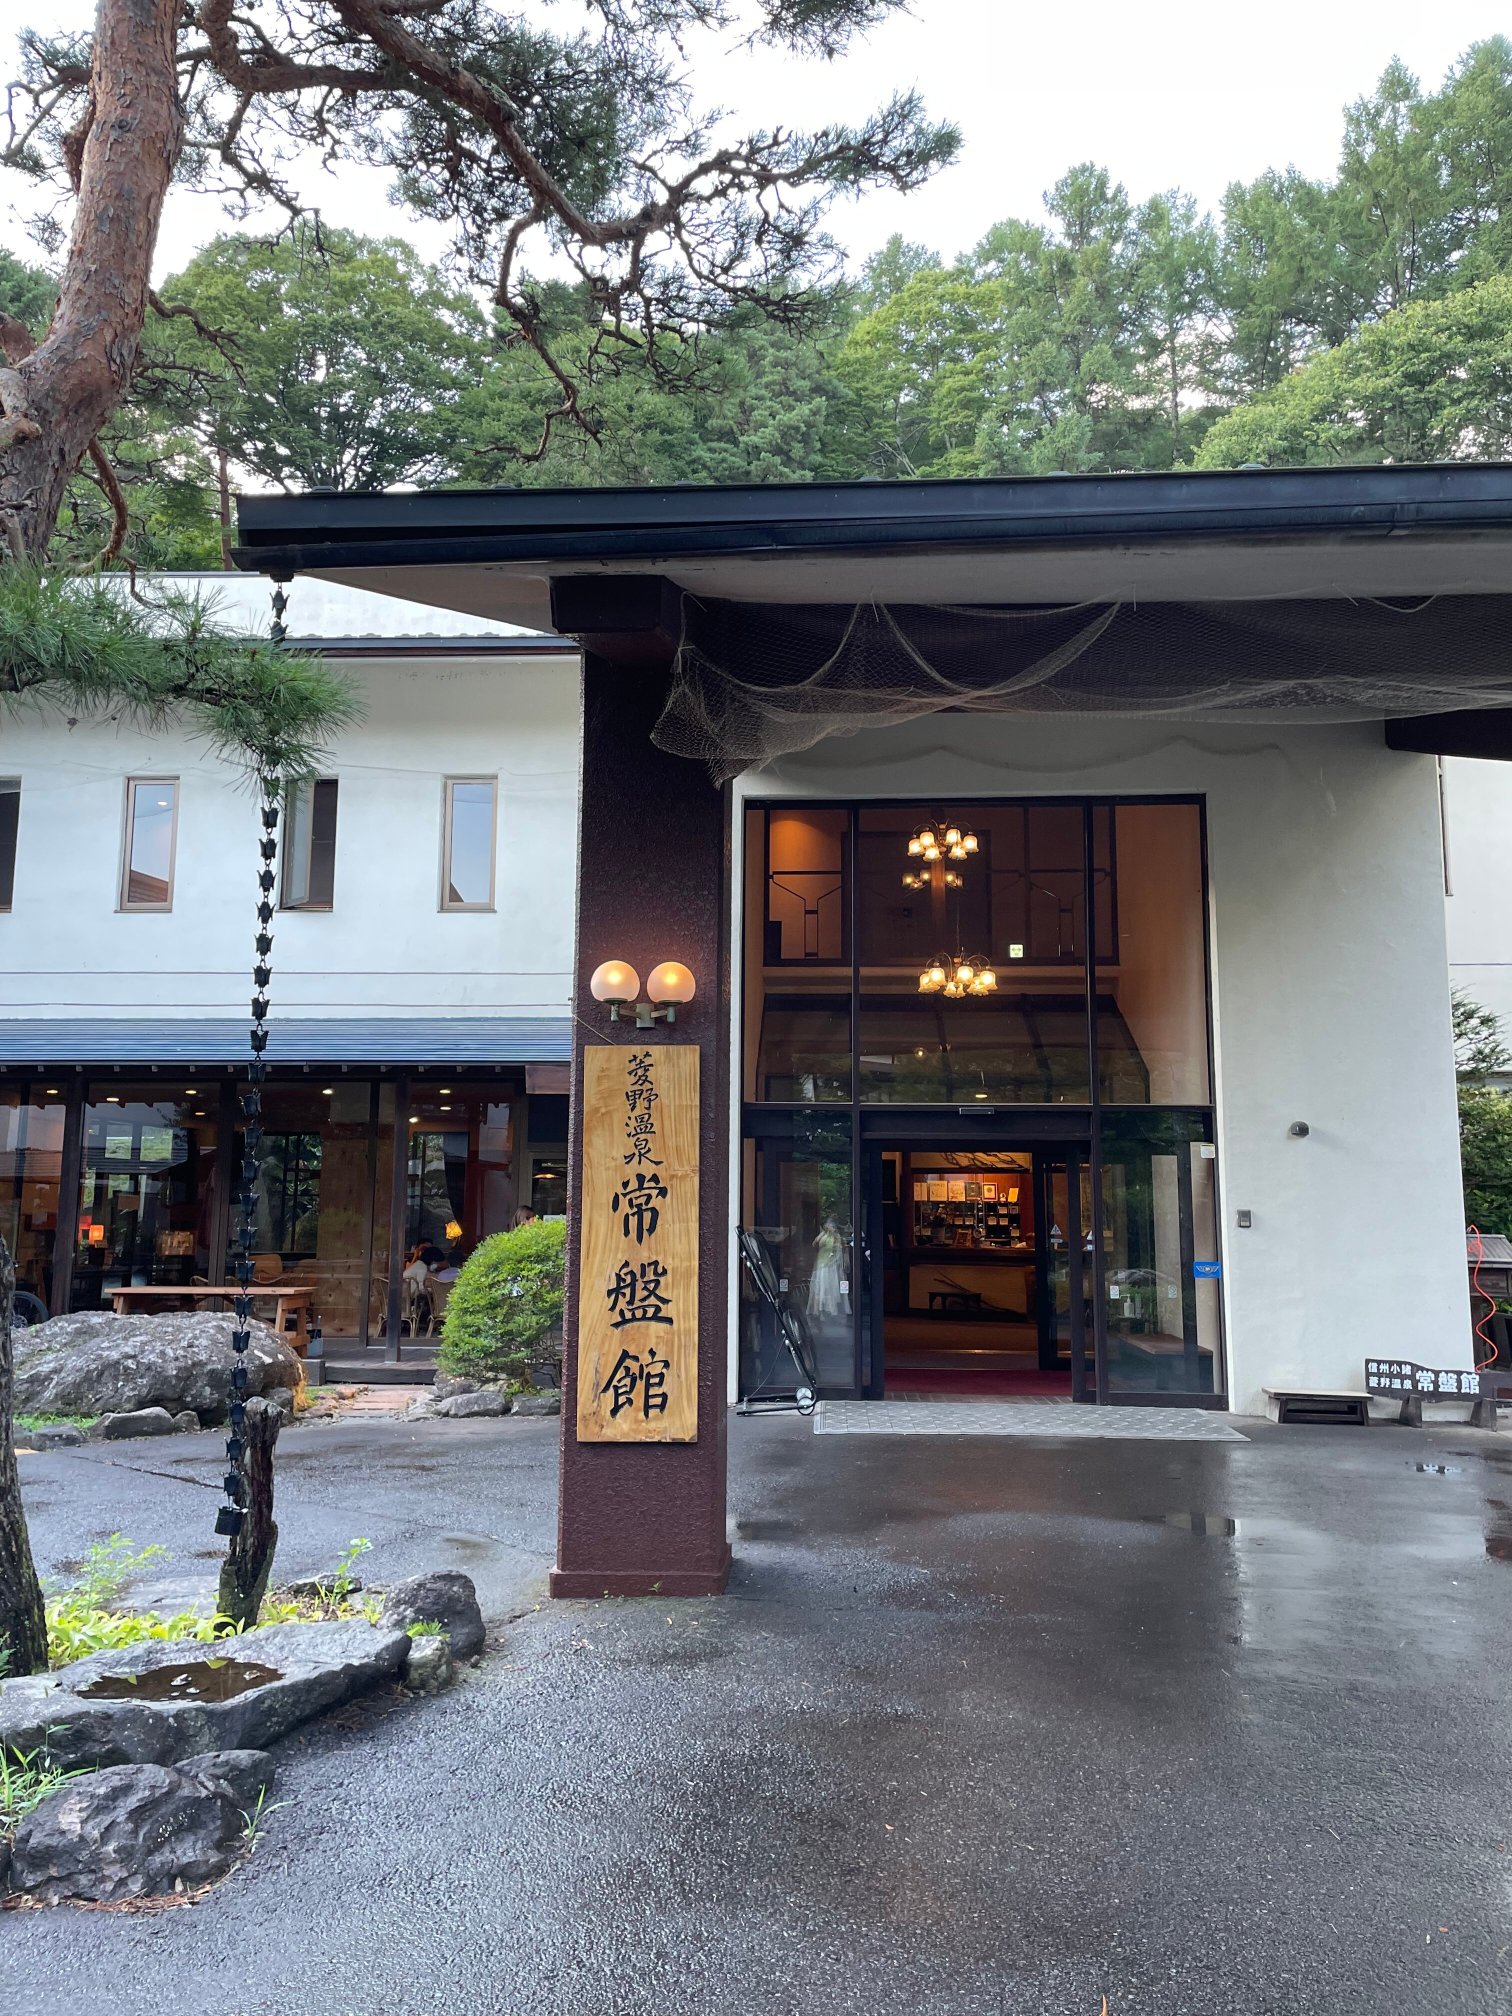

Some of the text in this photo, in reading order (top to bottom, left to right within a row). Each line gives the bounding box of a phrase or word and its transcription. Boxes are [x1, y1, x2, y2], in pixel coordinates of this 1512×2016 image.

[601, 1173, 674, 1421] 常盤館
[1415, 1370, 1480, 1395] 常盤館
